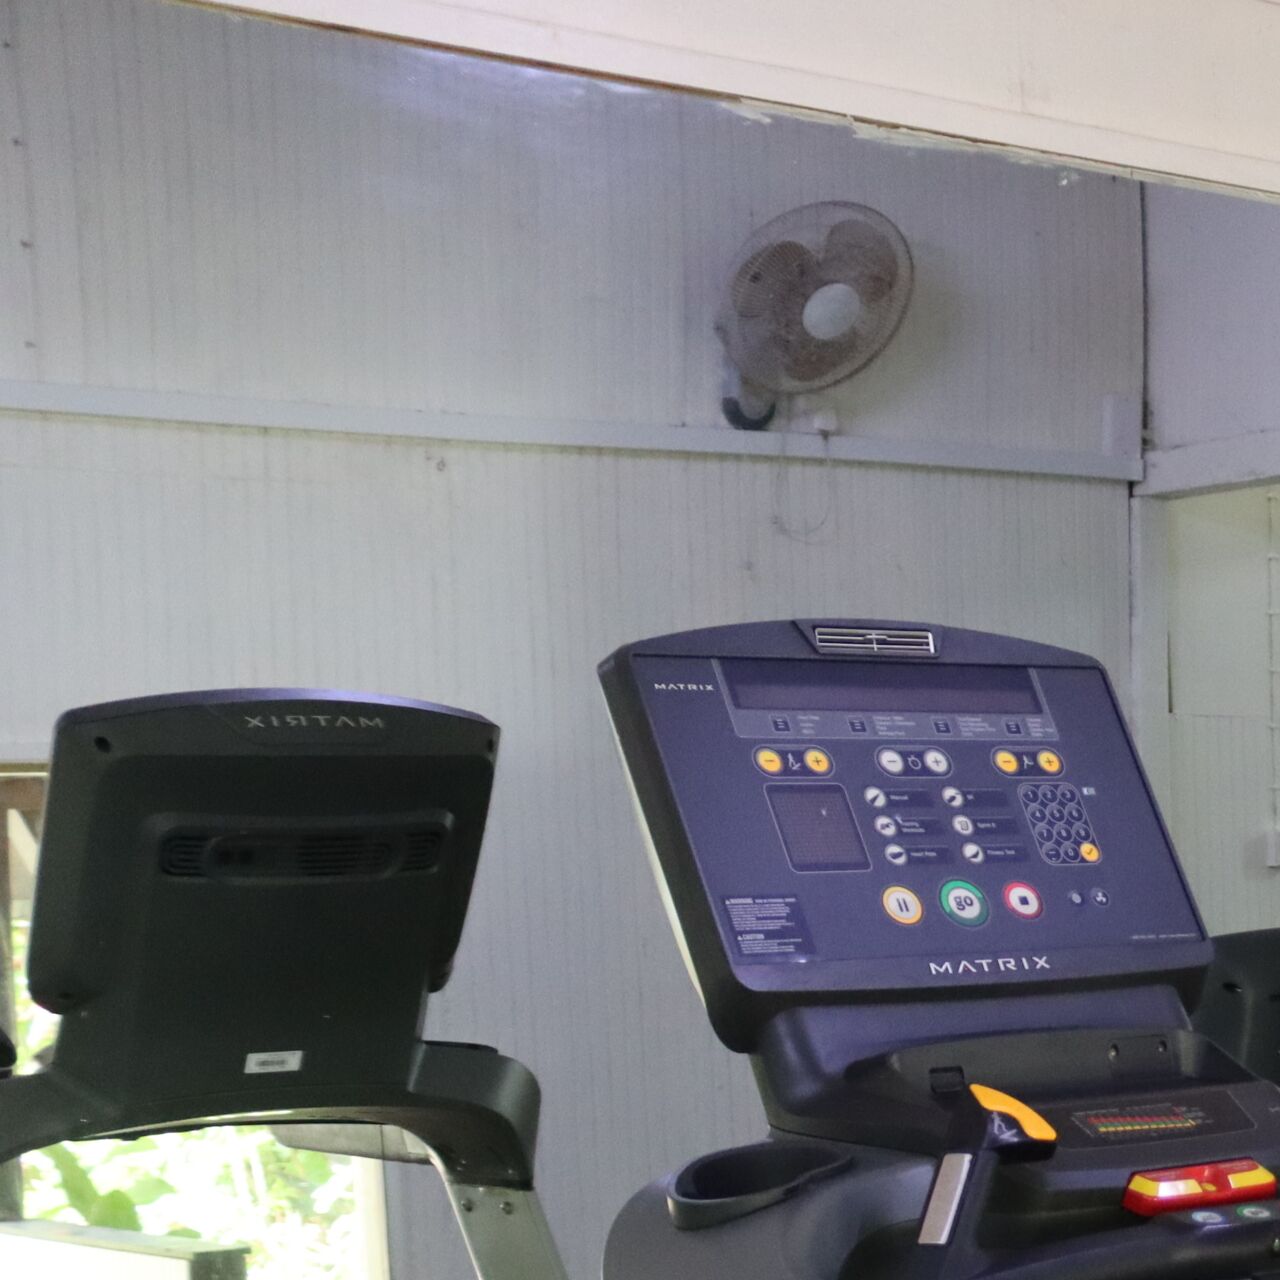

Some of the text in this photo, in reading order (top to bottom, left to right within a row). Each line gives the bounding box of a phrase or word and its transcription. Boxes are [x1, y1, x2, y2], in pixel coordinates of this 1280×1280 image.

[654, 683, 714, 691] MATRIX
[953, 895, 974, 911] go
[929, 956, 1051, 976] MATRIX
